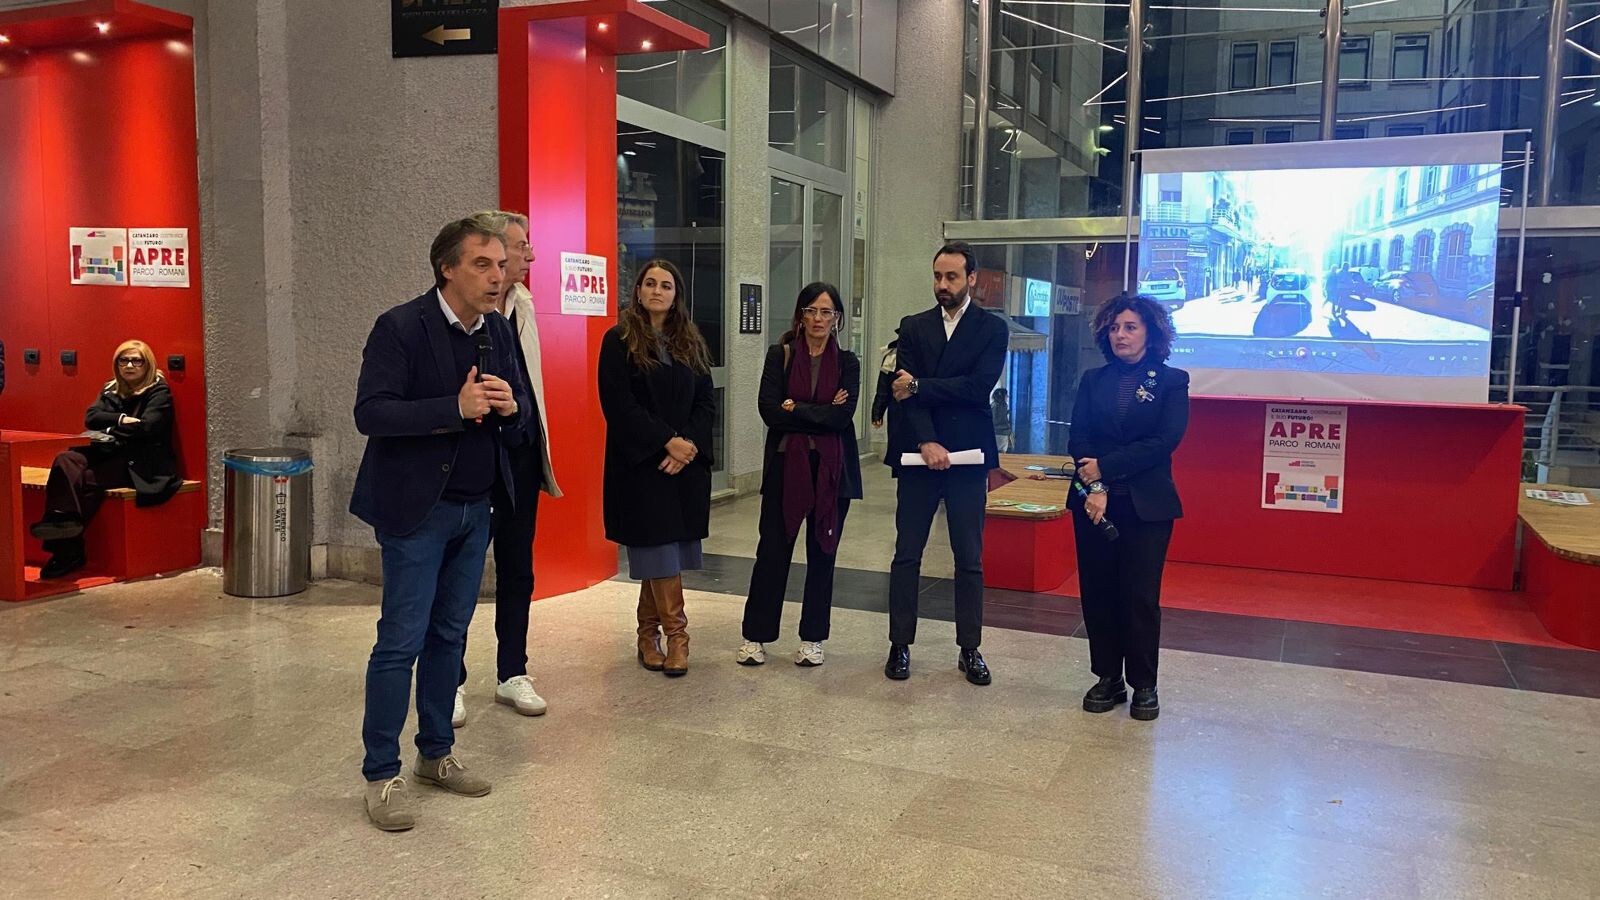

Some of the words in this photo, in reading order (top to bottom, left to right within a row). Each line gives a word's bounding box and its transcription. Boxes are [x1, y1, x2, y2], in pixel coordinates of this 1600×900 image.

[1151, 227, 1188, 238] THUN
[133, 247, 185, 266] APRE
[133, 267, 155, 276] PARCO
[159, 268, 185, 277] ROMANI
[565, 273, 605, 295] APRE
[565, 295, 587, 304] PARCO
[1269, 421, 1341, 441] APRE
[1269, 439, 1299, 448] PARCO
[1304, 441, 1341, 450] ROMANI
